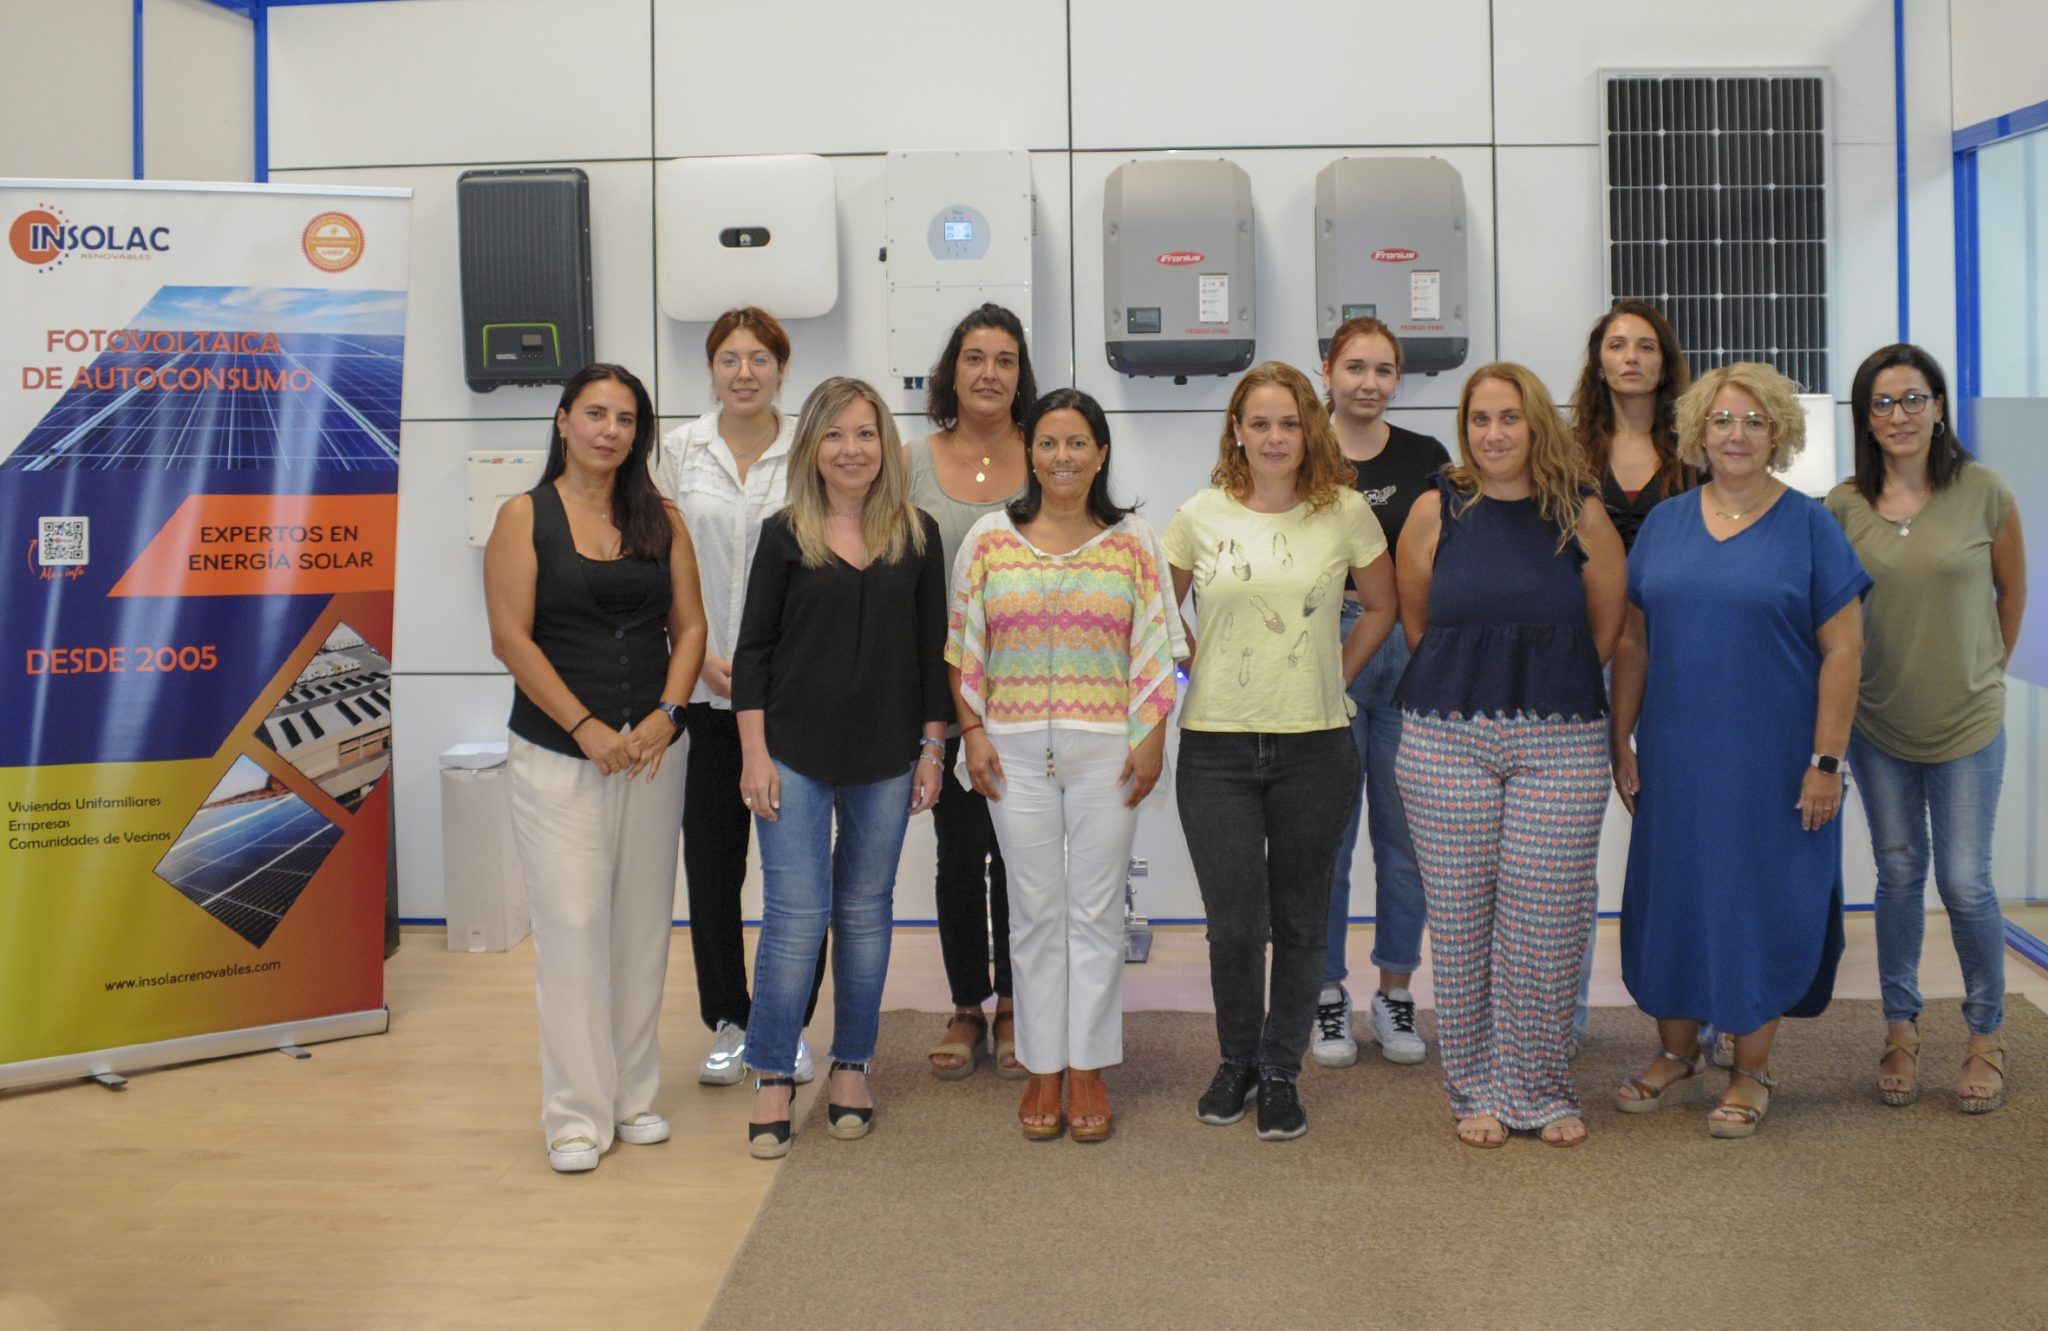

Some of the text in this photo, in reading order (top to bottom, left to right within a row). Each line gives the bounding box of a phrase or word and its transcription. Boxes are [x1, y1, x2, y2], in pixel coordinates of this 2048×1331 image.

[31, 225, 170, 252] INSOLAC
[80, 252, 152, 261] RENOVABLES
[1160, 254, 1202, 263] Fronius
[1375, 250, 1416, 260] Fronius
[46, 329, 282, 354] FOTOVOLTAICA
[22, 366, 312, 392] DE AUTOCONSUMO
[200, 525, 359, 543] EXPERTOS EN
[188, 549, 373, 571] ENERGÍA SOLAR
[64, 565, 85, 581] info
[26, 645, 218, 675] DESDE 2005
[8, 796, 161, 813] Viviendas Unifamiliares
[8, 819, 70, 832] Empresas
[8, 831, 171, 850] Comunidades de Vecinos
[104, 960, 282, 992] www.insolacrenovables.com
